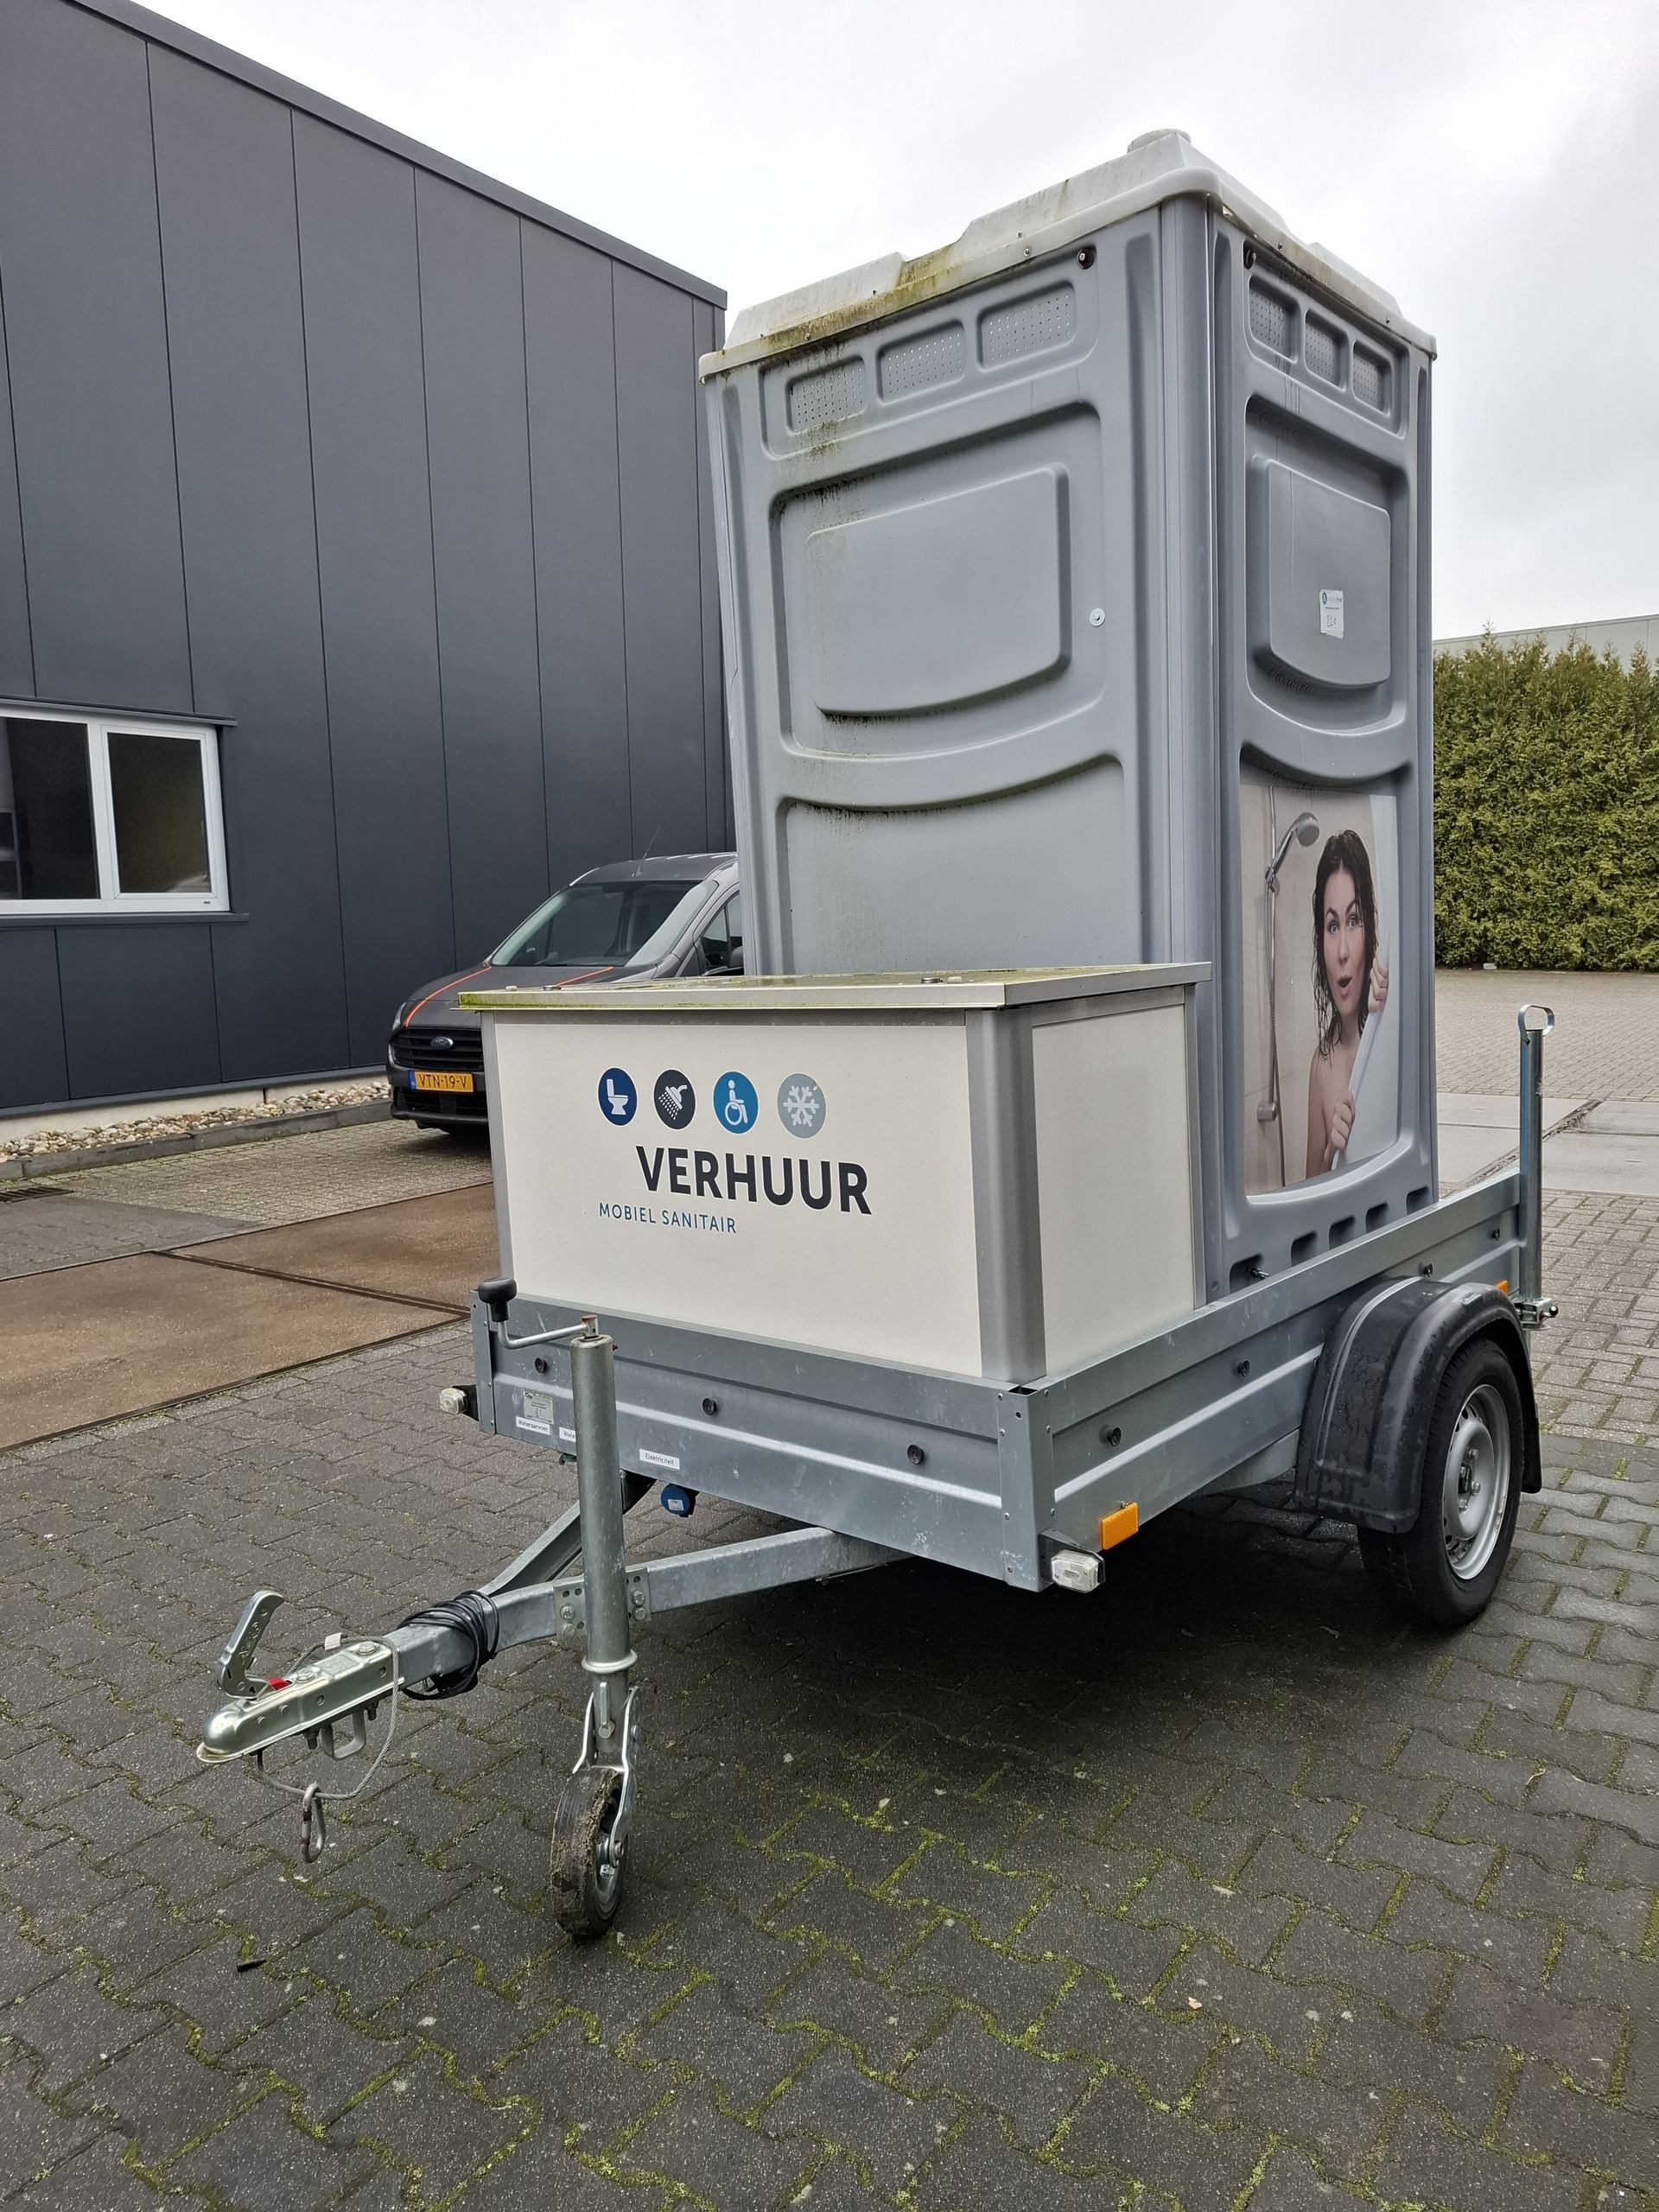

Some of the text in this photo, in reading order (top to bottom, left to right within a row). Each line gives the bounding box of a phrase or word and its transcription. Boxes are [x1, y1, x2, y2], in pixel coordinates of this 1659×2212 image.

[419, 1074, 467, 1089] VTN-19-V
[635, 1145, 873, 1215] VERHUUR
[599, 1202, 737, 1234] MOBIEL SANITAIR
[518, 1419, 549, 1433] Wateraanvoer
[563, 1430, 575, 1440] Wate
[645, 1452, 675, 1466] Elektriciteit
